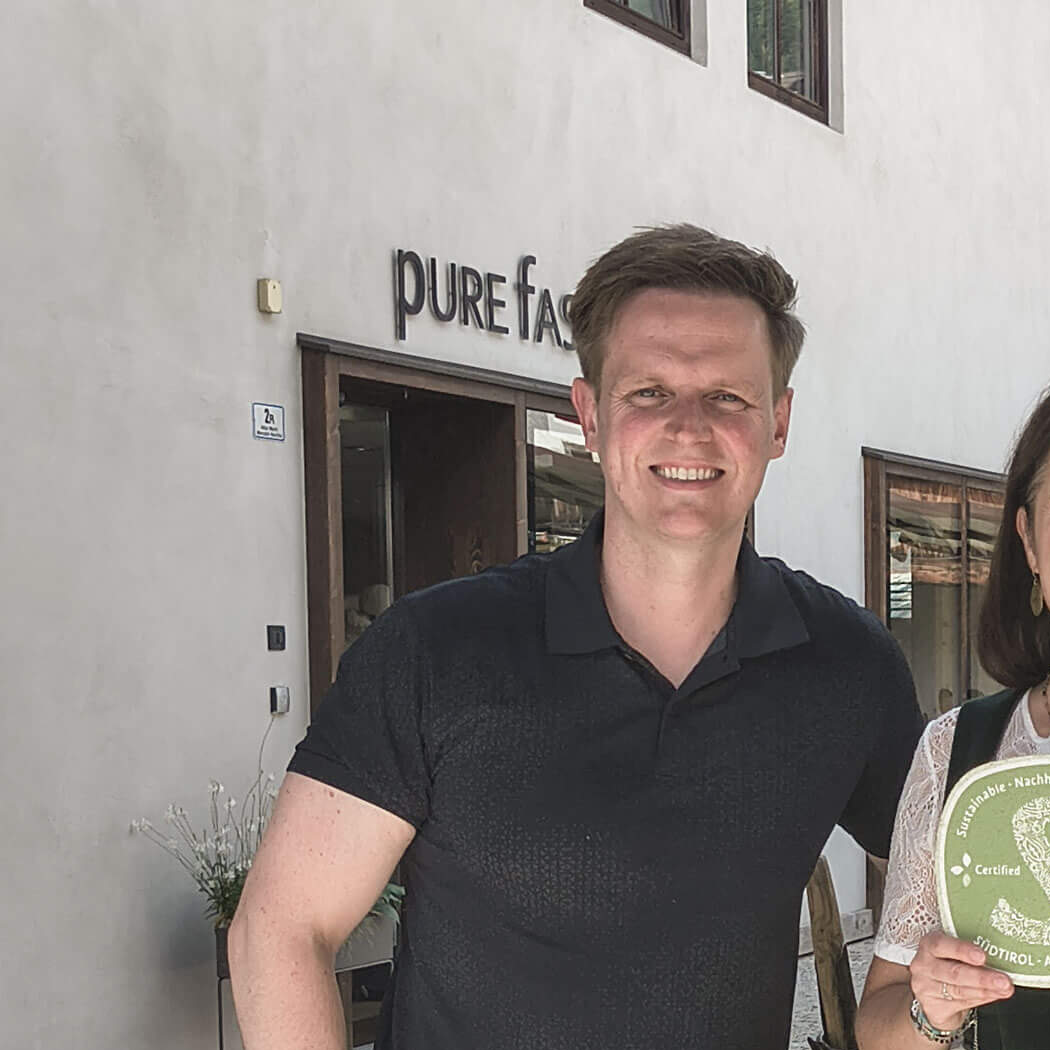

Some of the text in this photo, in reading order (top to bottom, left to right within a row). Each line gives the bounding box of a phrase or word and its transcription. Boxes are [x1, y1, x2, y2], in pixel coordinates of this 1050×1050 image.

[956, 782, 1007, 838] Sustainable
[975, 863, 1021, 876] Certified
[973, 936, 1035, 966] SÜDTIROL
